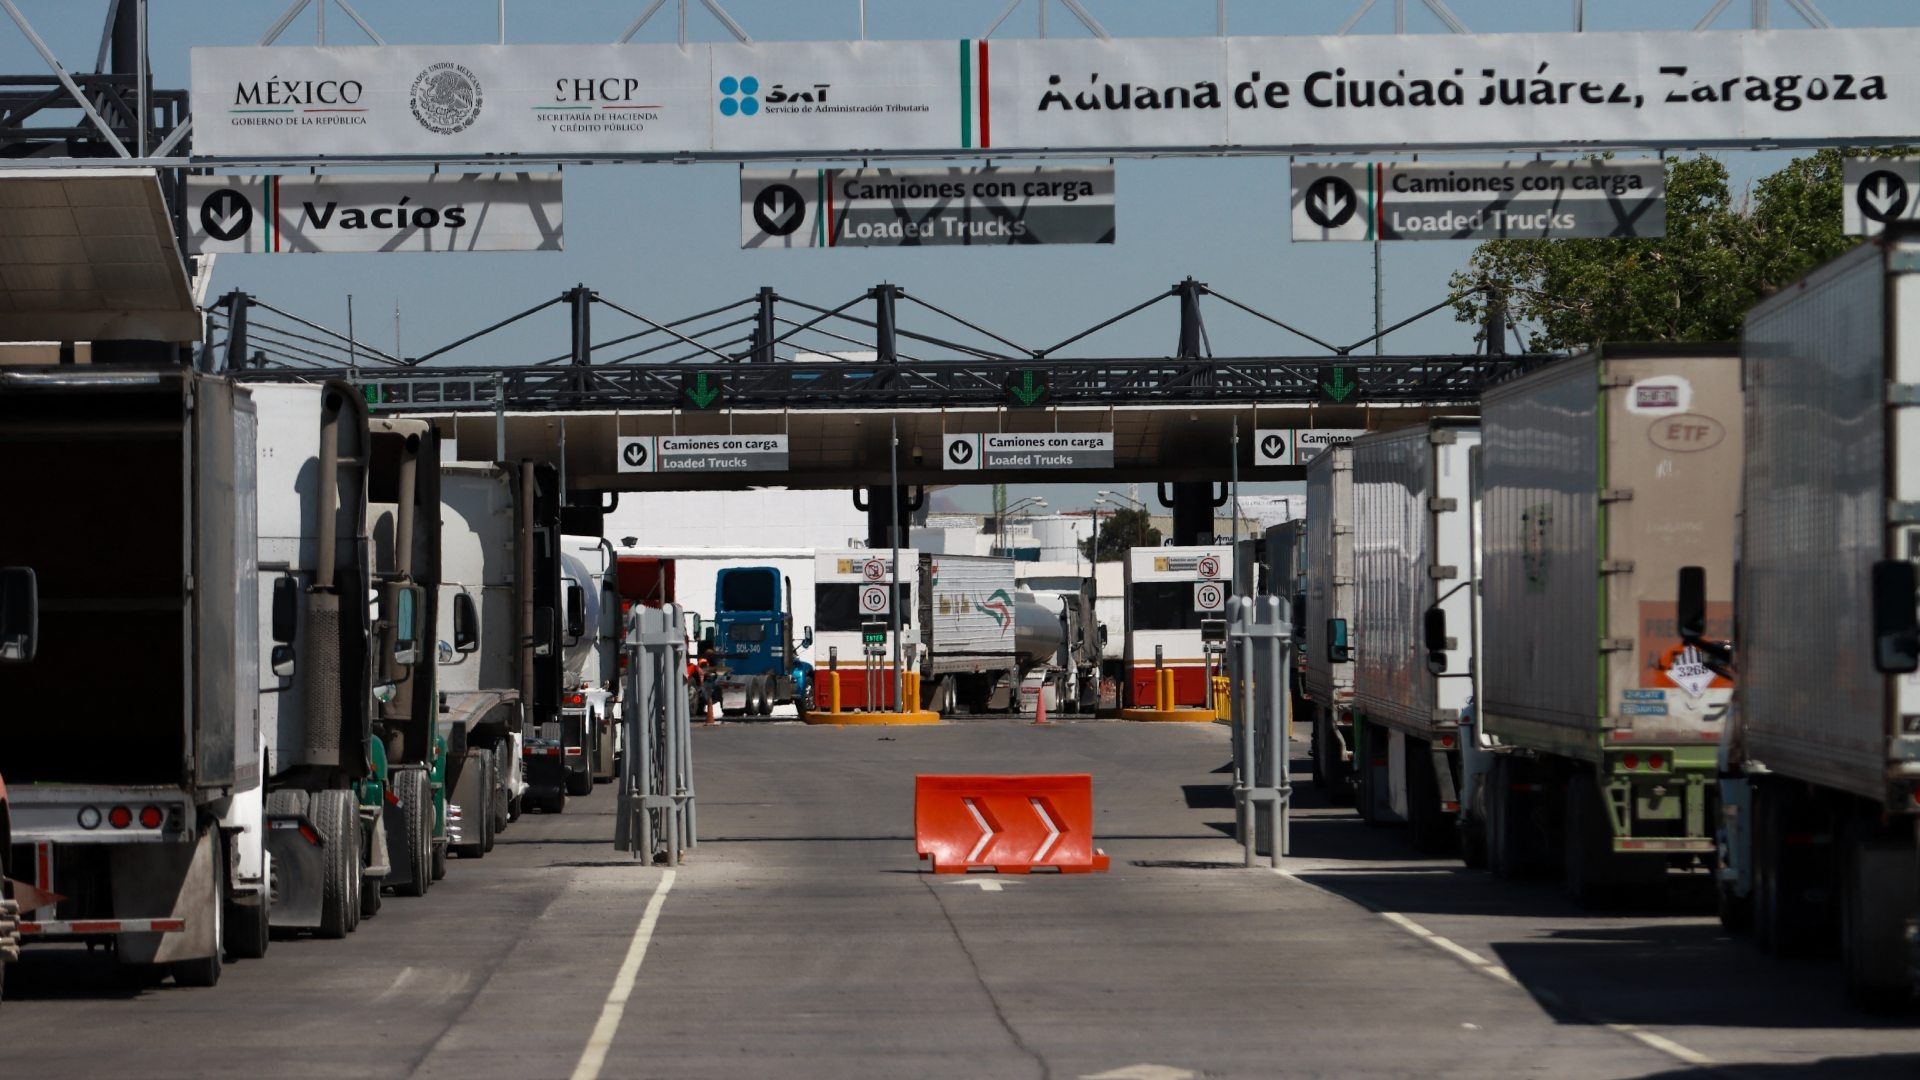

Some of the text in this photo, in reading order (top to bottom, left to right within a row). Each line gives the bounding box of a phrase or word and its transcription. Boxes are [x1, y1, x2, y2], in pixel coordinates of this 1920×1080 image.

[428, 62, 455, 72] UNIDOS
[234, 75, 363, 105] MÉXICO
[556, 77, 639, 101] SHCP
[1038, 61, 1889, 112] Aduana de Ciudad Juárez, Zaragoza
[765, 104, 930, 114] Servicio de Administración Tributaria
[231, 115, 367, 126] GOBIERNO DE LA REPÚBLICA
[537, 112, 658, 121] SECRETARÍA DE HACIENDA
[551, 122, 644, 132] Y CRÉDITO PÚBLICO
[1392, 171, 1643, 195] Camiones con carga
[843, 178, 1095, 201] Camiones con carga
[303, 196, 467, 230] Vacíos
[843, 215, 1026, 239] Loaded Trucks
[1393, 209, 1576, 233] Loaded Trucks
[1301, 432, 1354, 444] Camione
[1666, 423, 1710, 441] ETF
[663, 439, 778, 451] Camiones con carga
[989, 436, 1104, 449] Camiones con carga
[663, 457, 748, 469] Loaded Trucks
[989, 454, 1074, 466] Loaded Trucks
[868, 594, 881, 605] 10
[1202, 592, 1216, 603] 10
